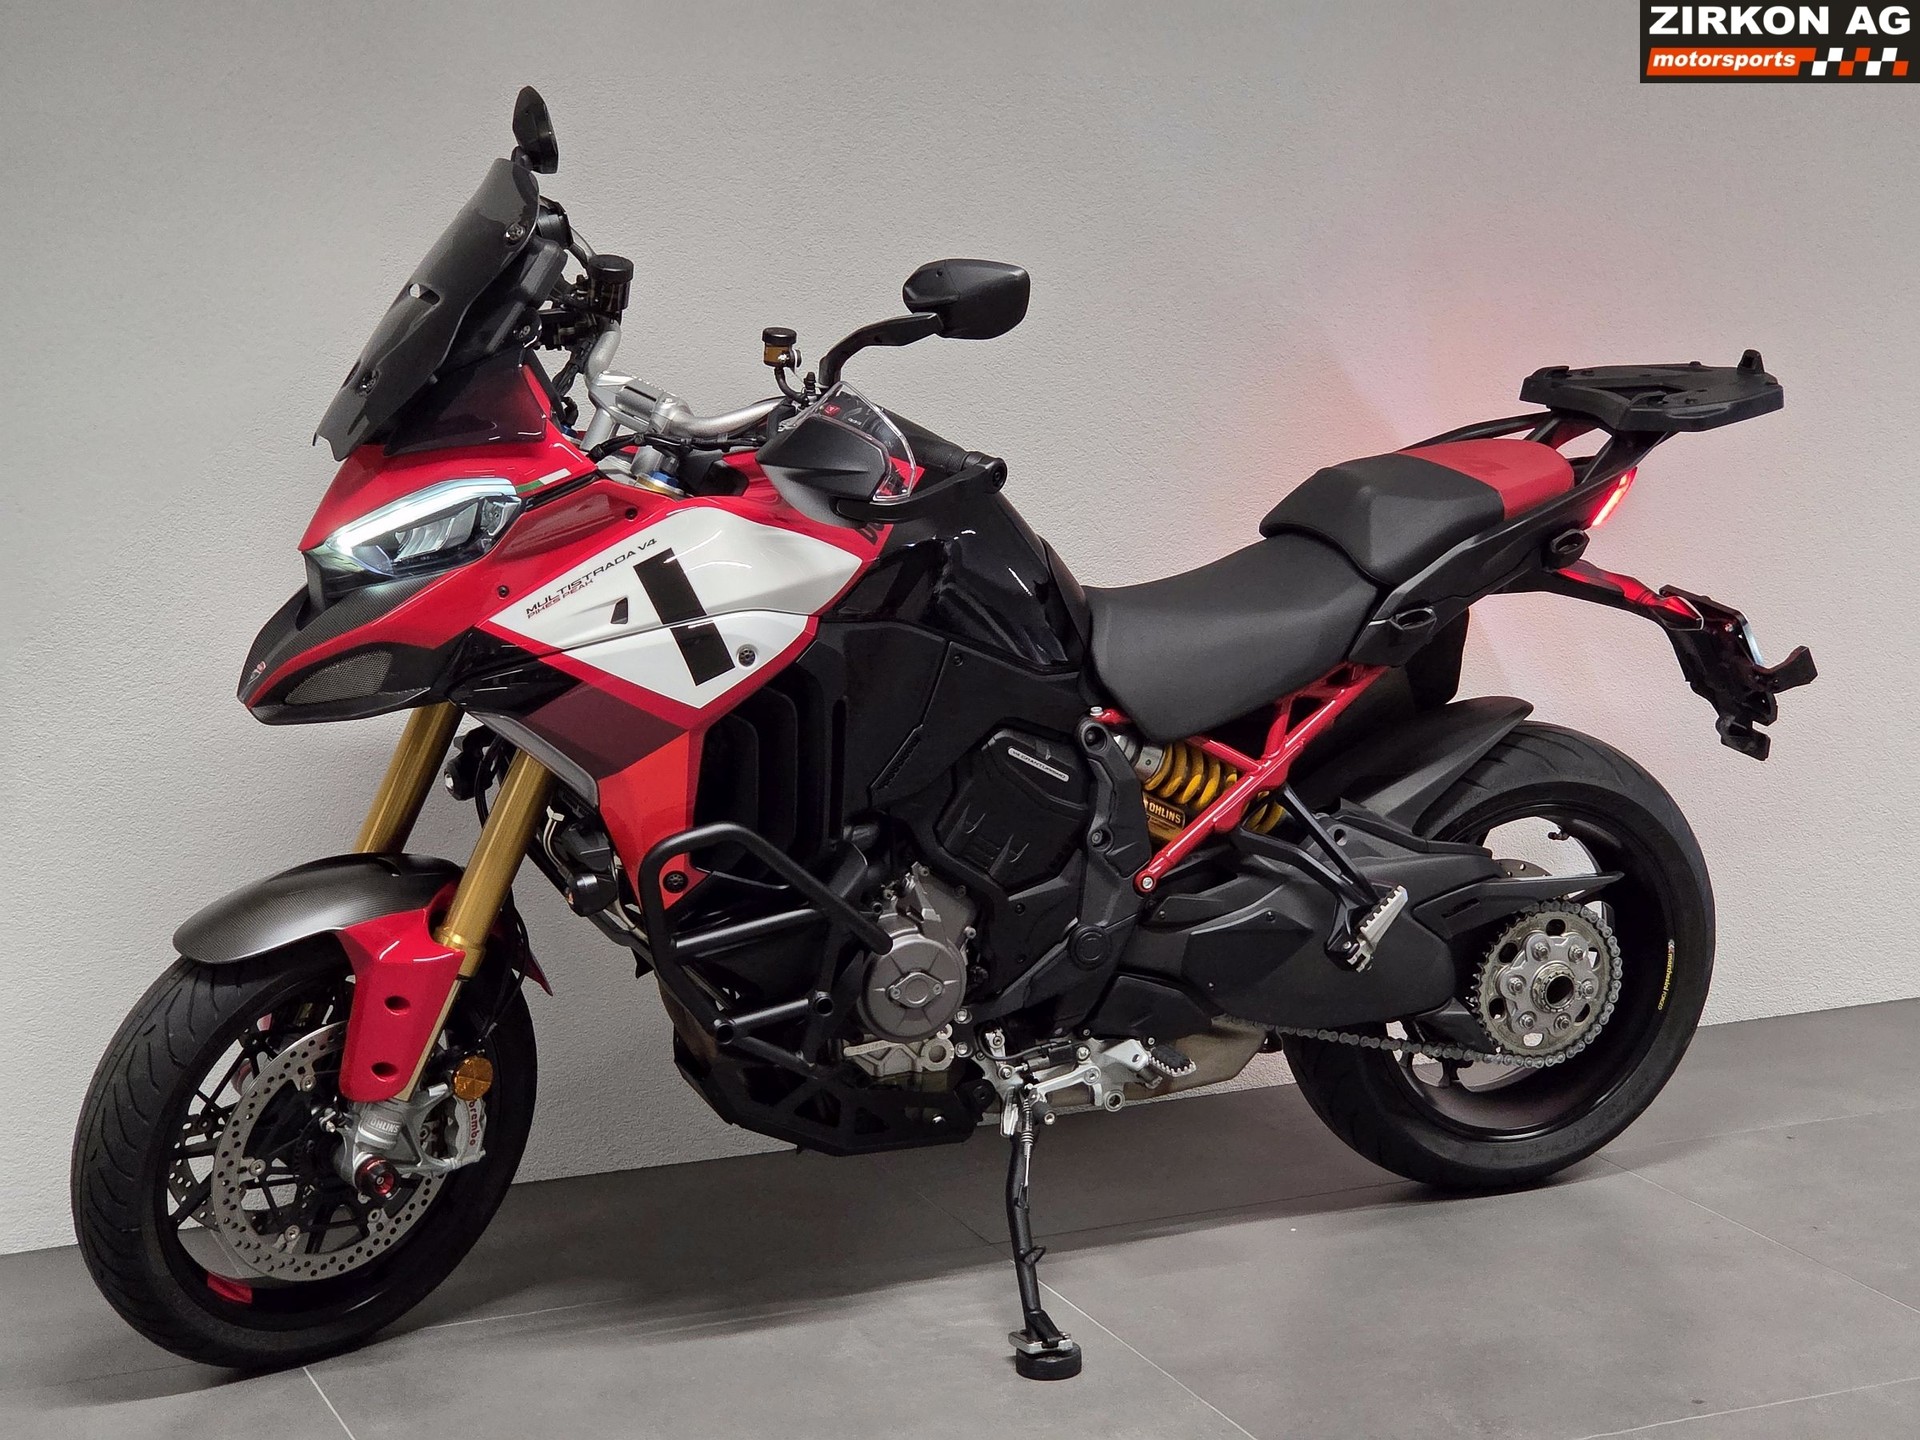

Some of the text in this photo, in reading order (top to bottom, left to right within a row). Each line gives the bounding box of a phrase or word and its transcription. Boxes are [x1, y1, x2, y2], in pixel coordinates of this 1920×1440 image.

[525, 538, 657, 615] MULTISTRADA V4
[527, 579, 594, 619] PIKES PEAK
